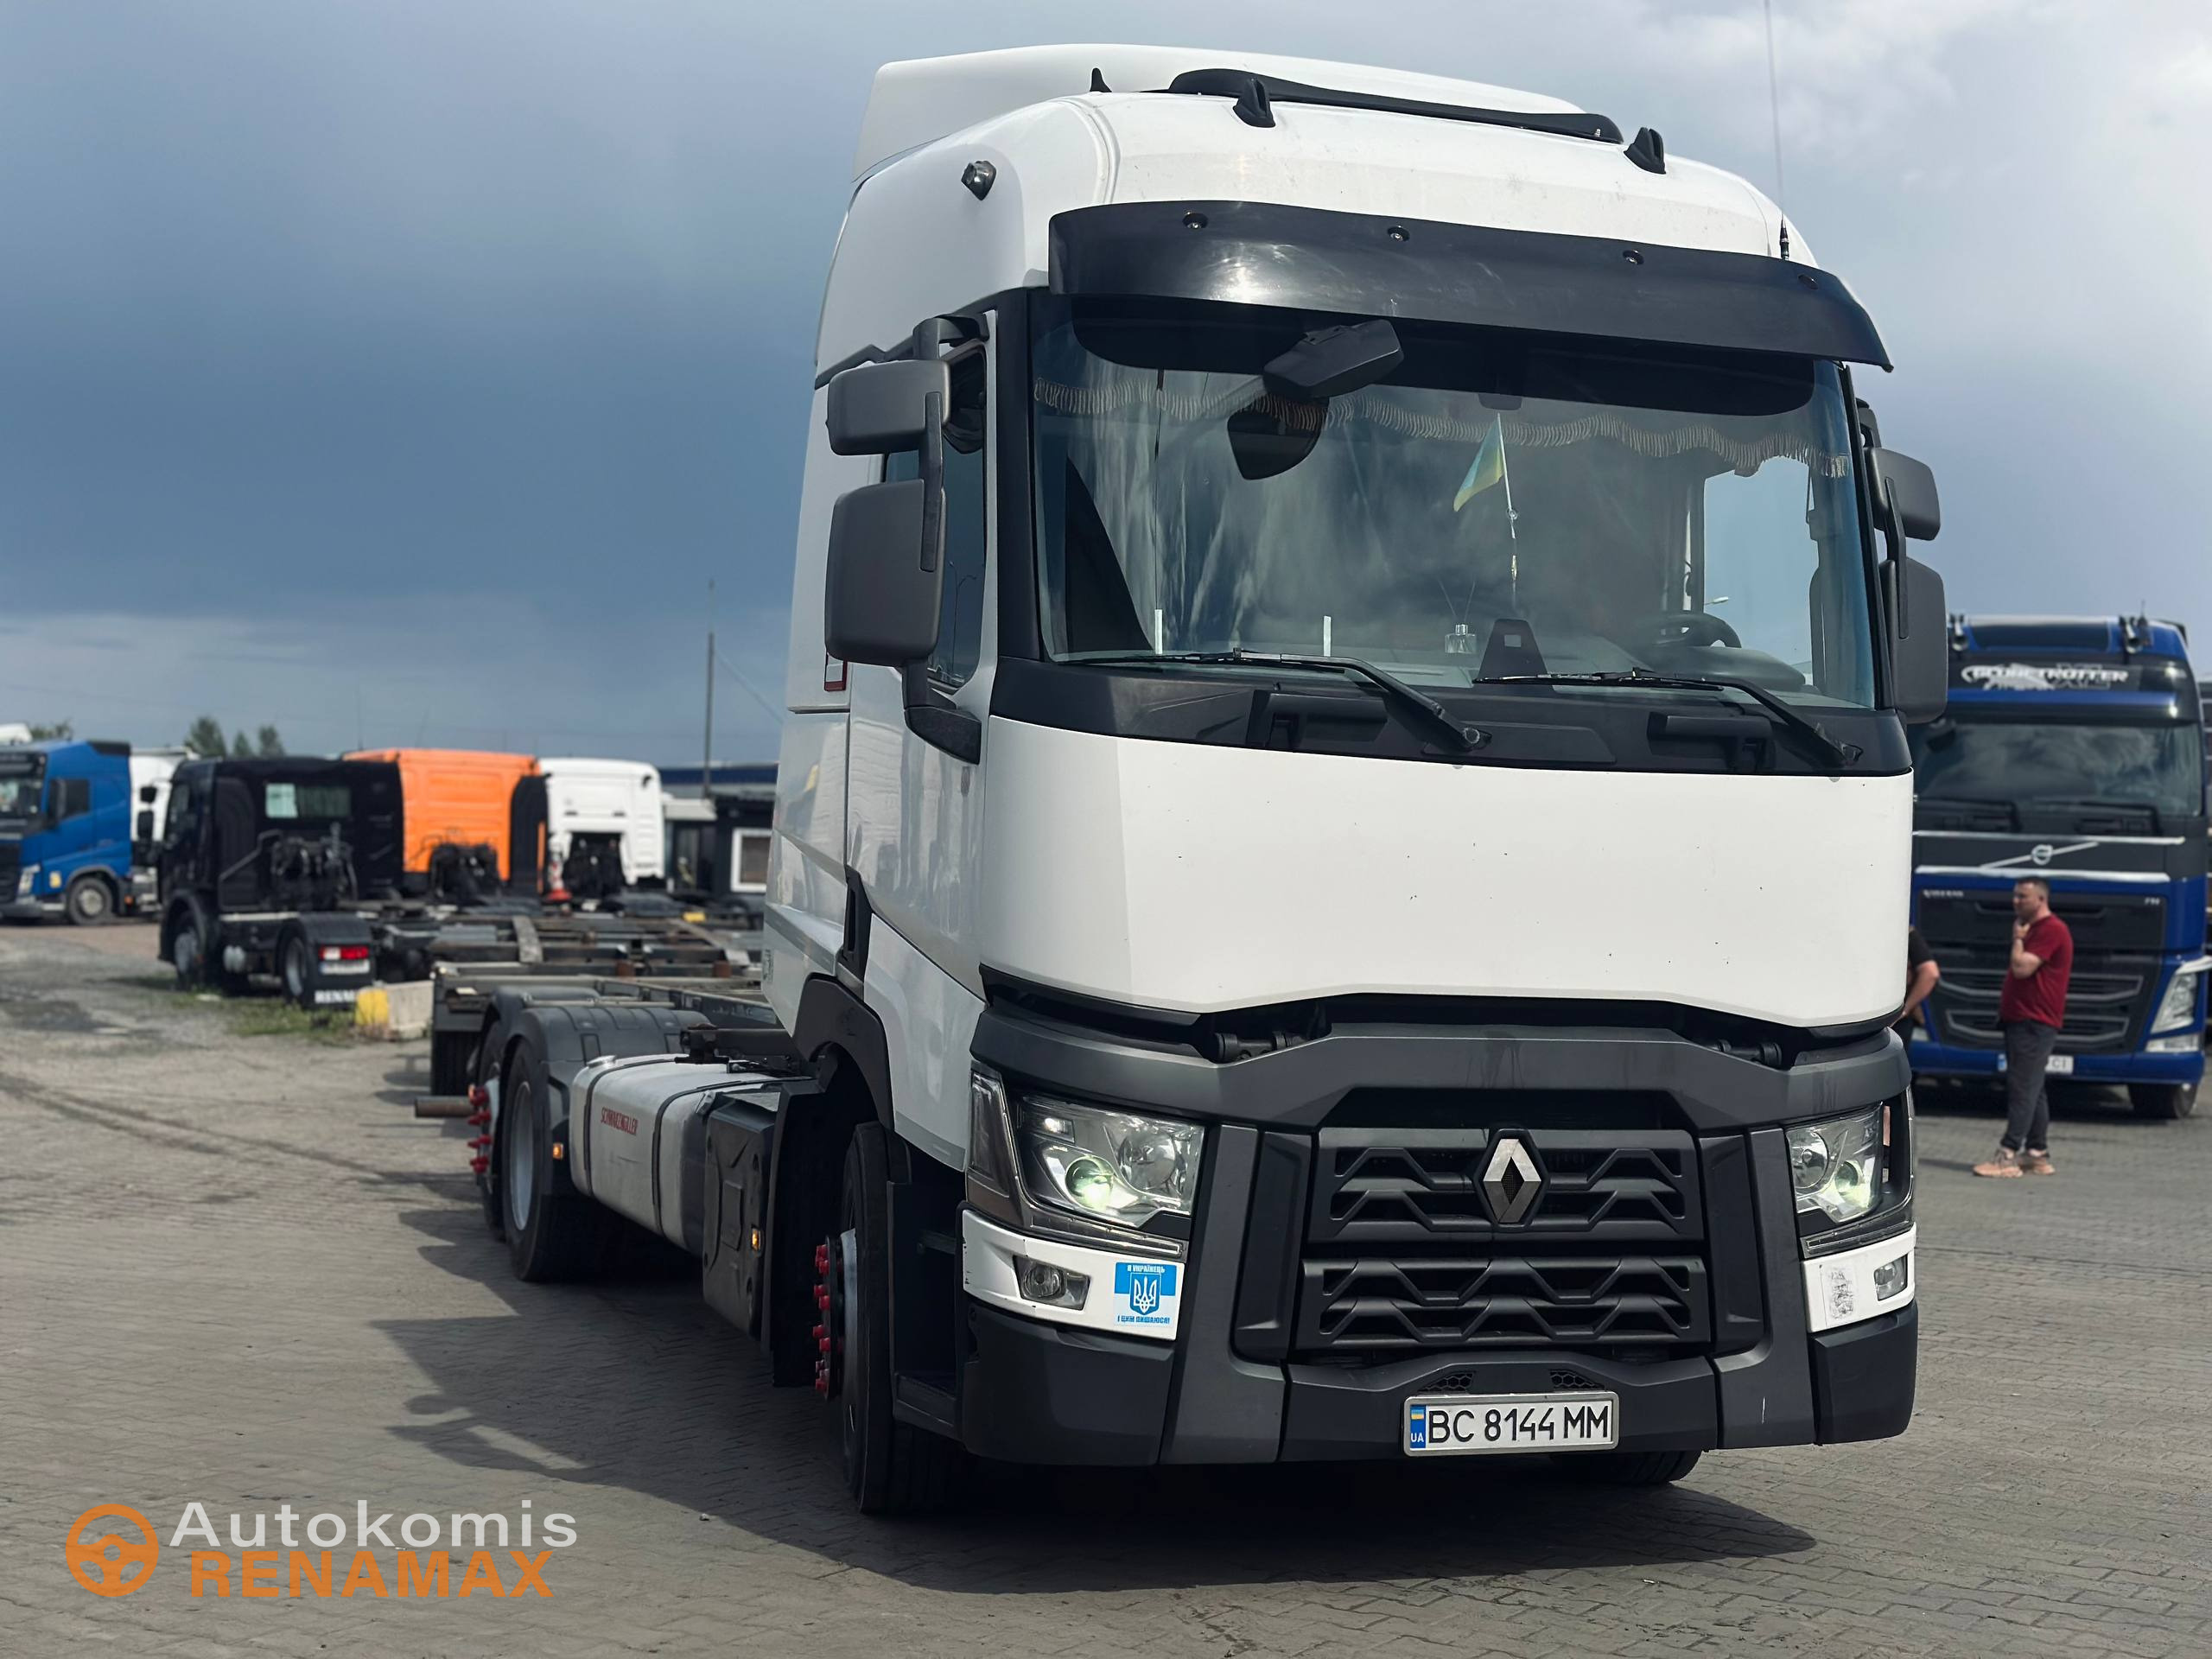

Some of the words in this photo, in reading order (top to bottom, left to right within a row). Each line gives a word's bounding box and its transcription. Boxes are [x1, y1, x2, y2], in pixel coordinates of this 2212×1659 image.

[315, 990, 355, 1003] RENA
[1428, 1409, 1475, 1444] BC
[1484, 1408, 1554, 1442] 8144
[1564, 1406, 1609, 1439] MM
[1410, 1433, 1425, 1443] UA
